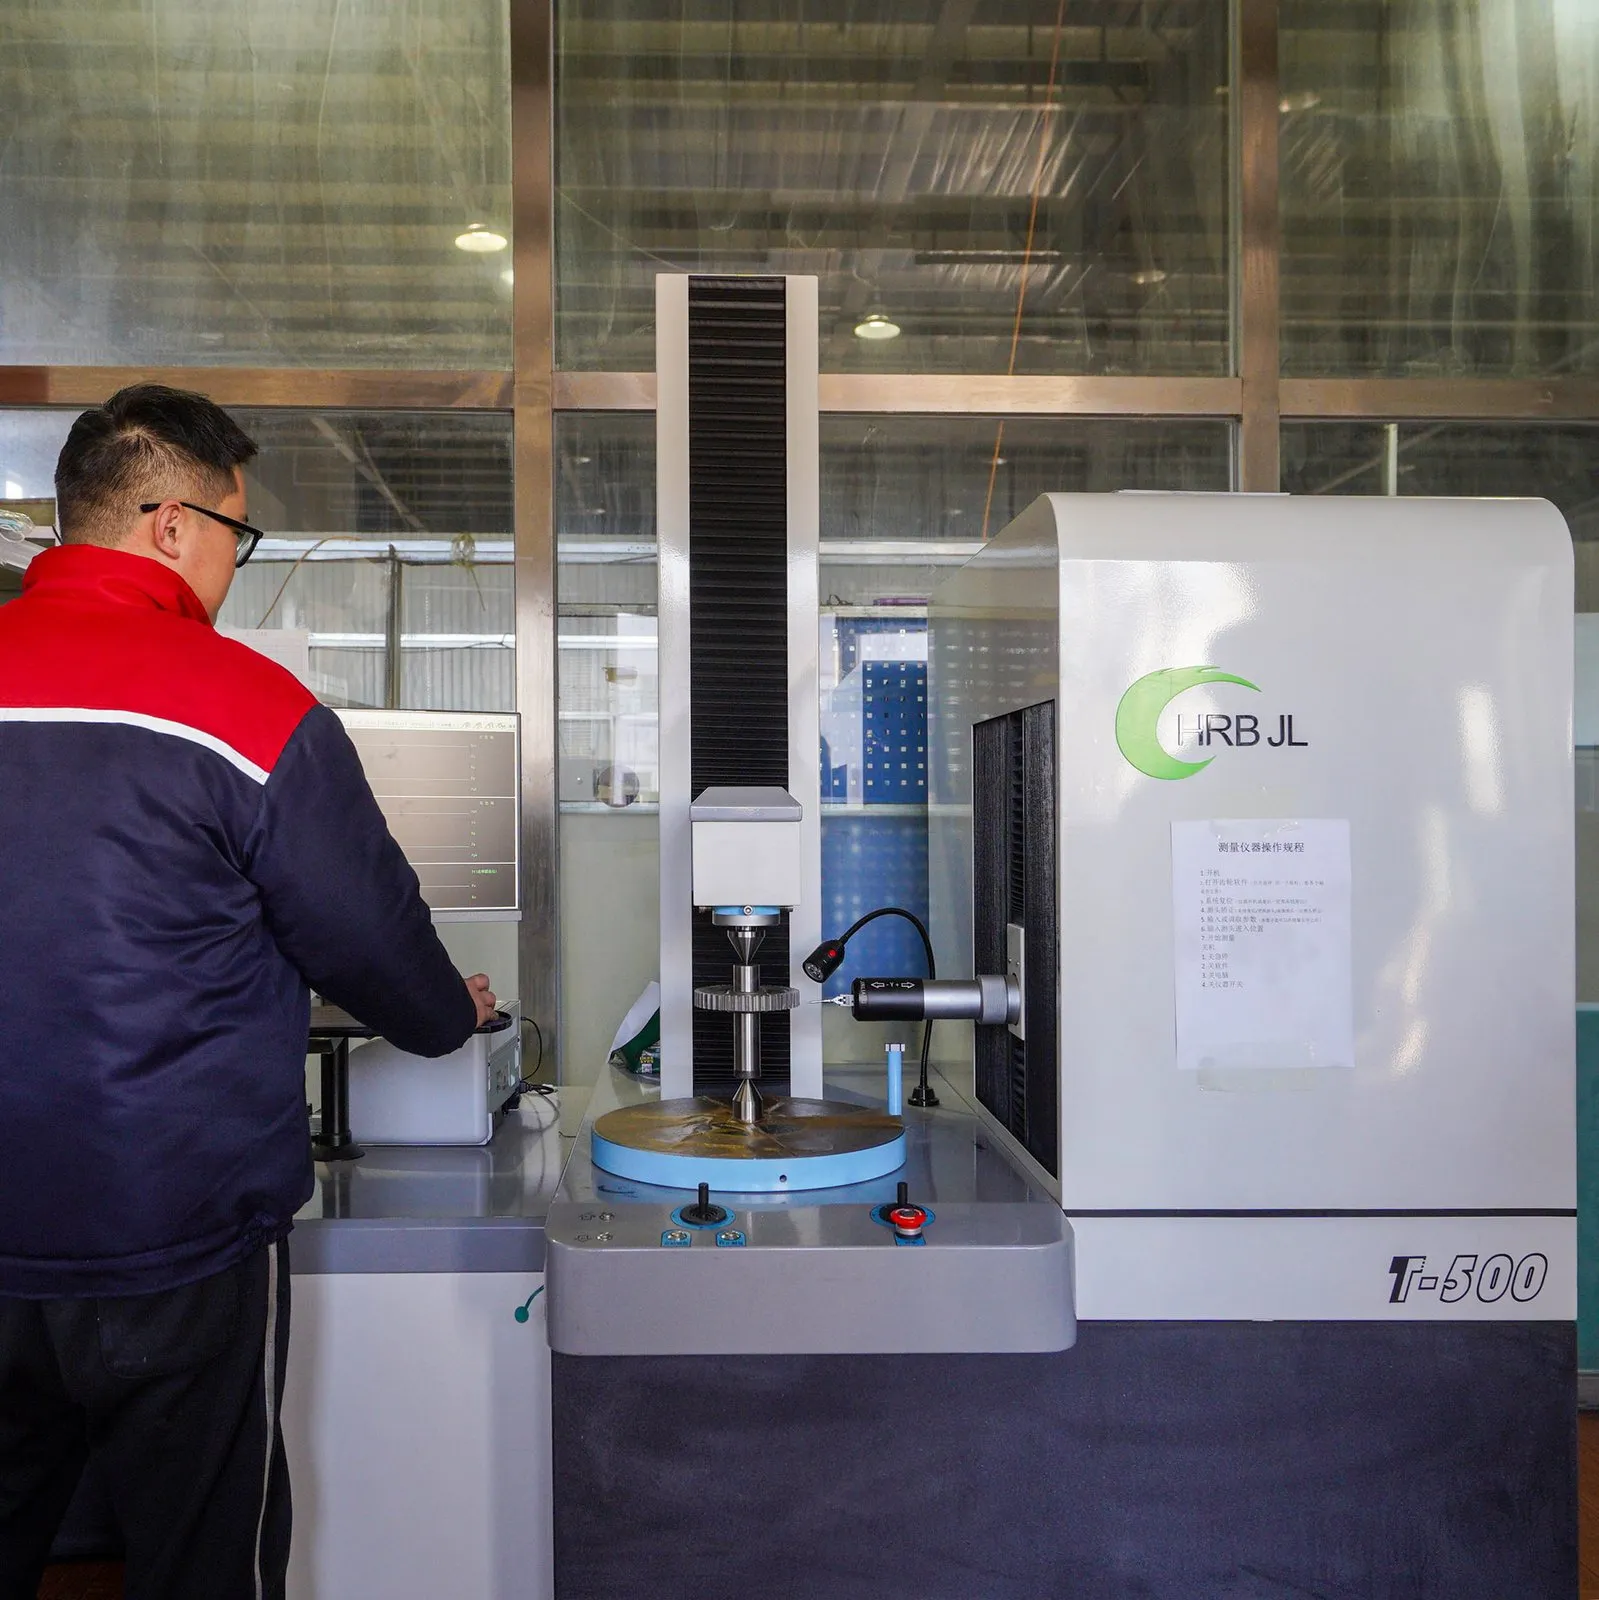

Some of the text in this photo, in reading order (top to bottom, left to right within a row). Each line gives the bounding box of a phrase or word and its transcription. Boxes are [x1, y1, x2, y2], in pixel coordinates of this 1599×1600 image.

[1177, 714, 1309, 748] HRB JL
[1218, 842, 1305, 853] 测量仪器操作规程
[1388, 1252, 1549, 1304] T-500
